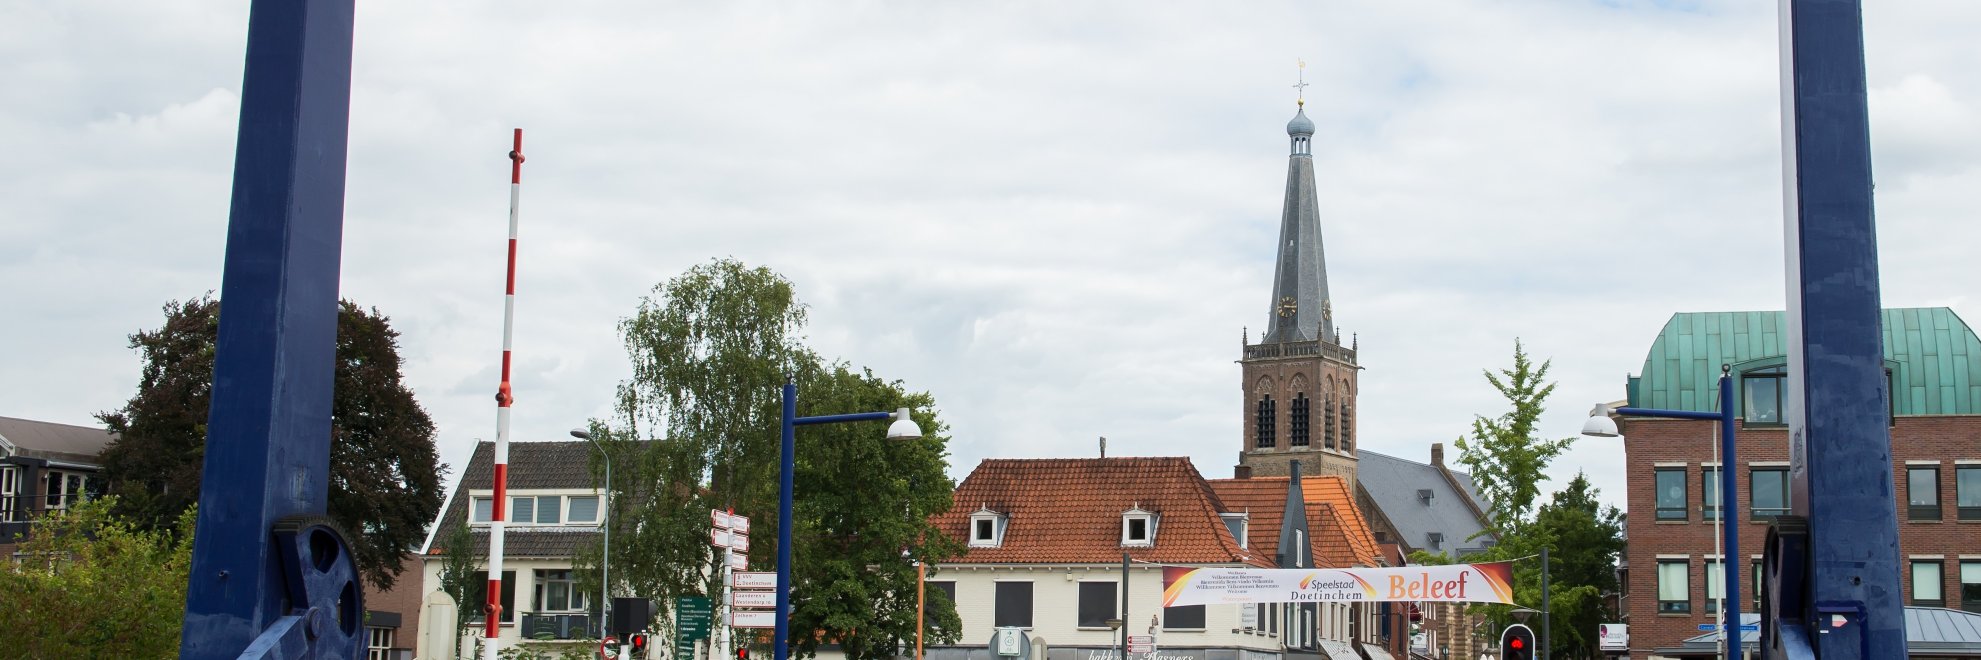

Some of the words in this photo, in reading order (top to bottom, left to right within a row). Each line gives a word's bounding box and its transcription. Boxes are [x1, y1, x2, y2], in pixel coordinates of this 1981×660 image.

[1311, 579, 1355, 590] Speelstad
[1387, 570, 1469, 599] Beleef
[1291, 590, 1362, 600] Doetinchem
